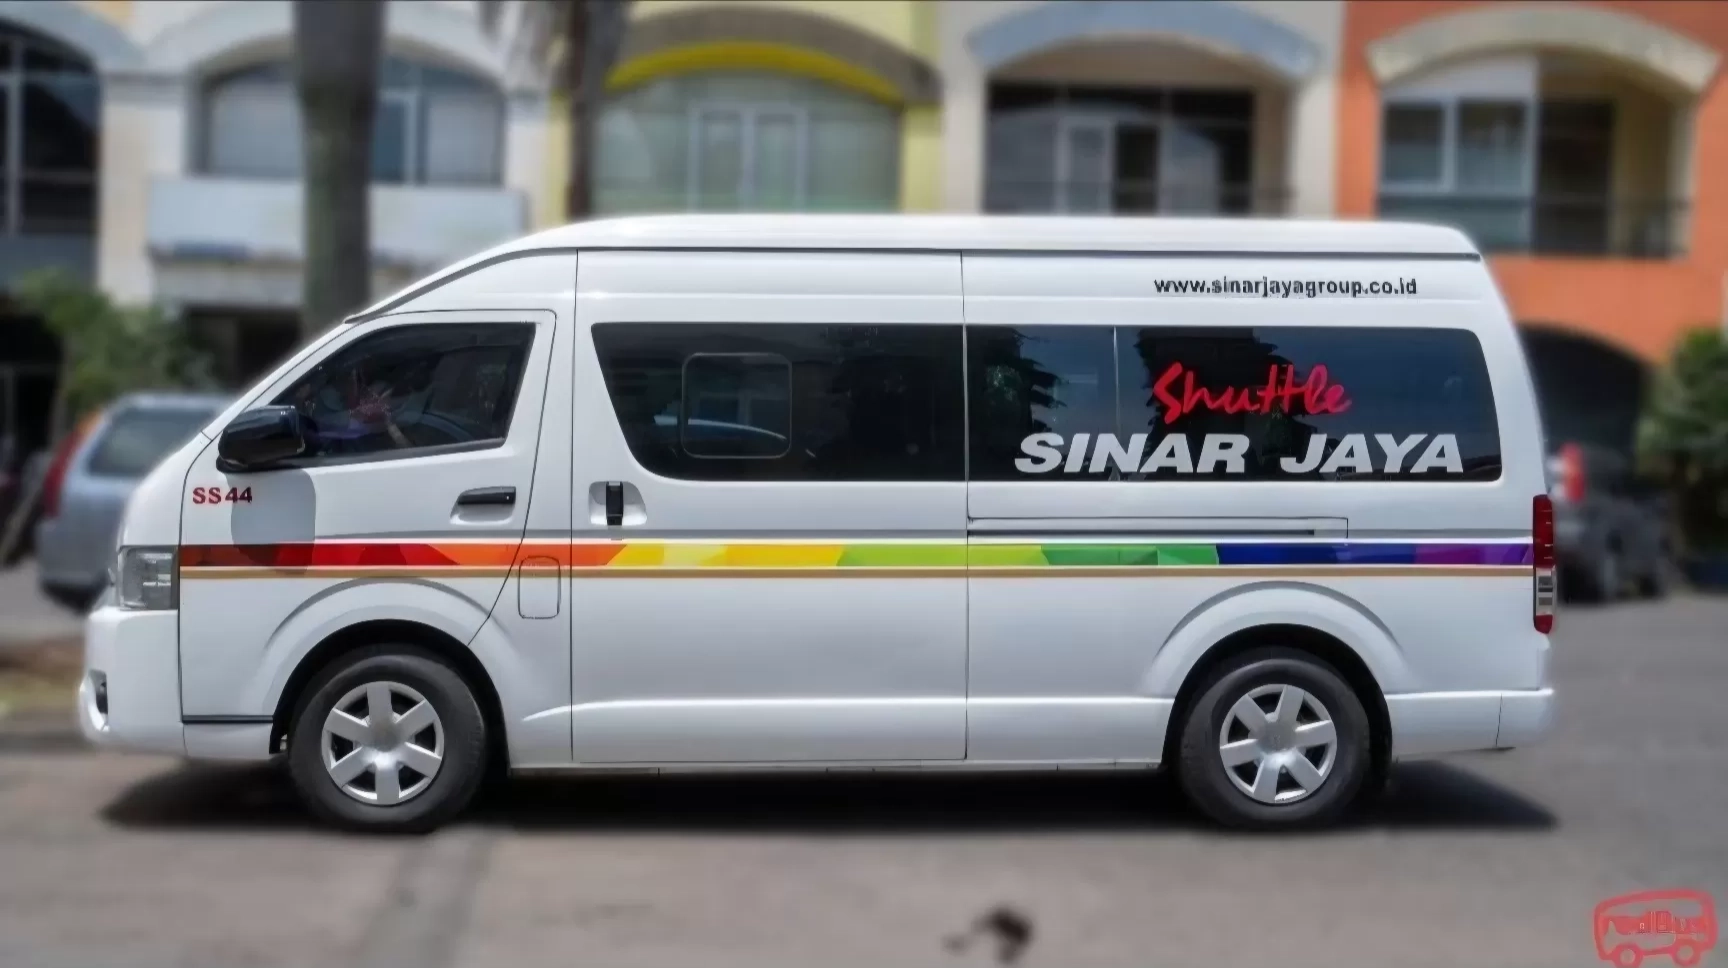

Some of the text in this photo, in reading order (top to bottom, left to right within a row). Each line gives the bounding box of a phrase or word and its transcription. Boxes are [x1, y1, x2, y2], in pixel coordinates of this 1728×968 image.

[1154, 276, 1417, 298] www.sinarjayagroup.co.id
[1153, 361, 1352, 424] Shuttle
[1014, 433, 1463, 473] SINAR JAYA
